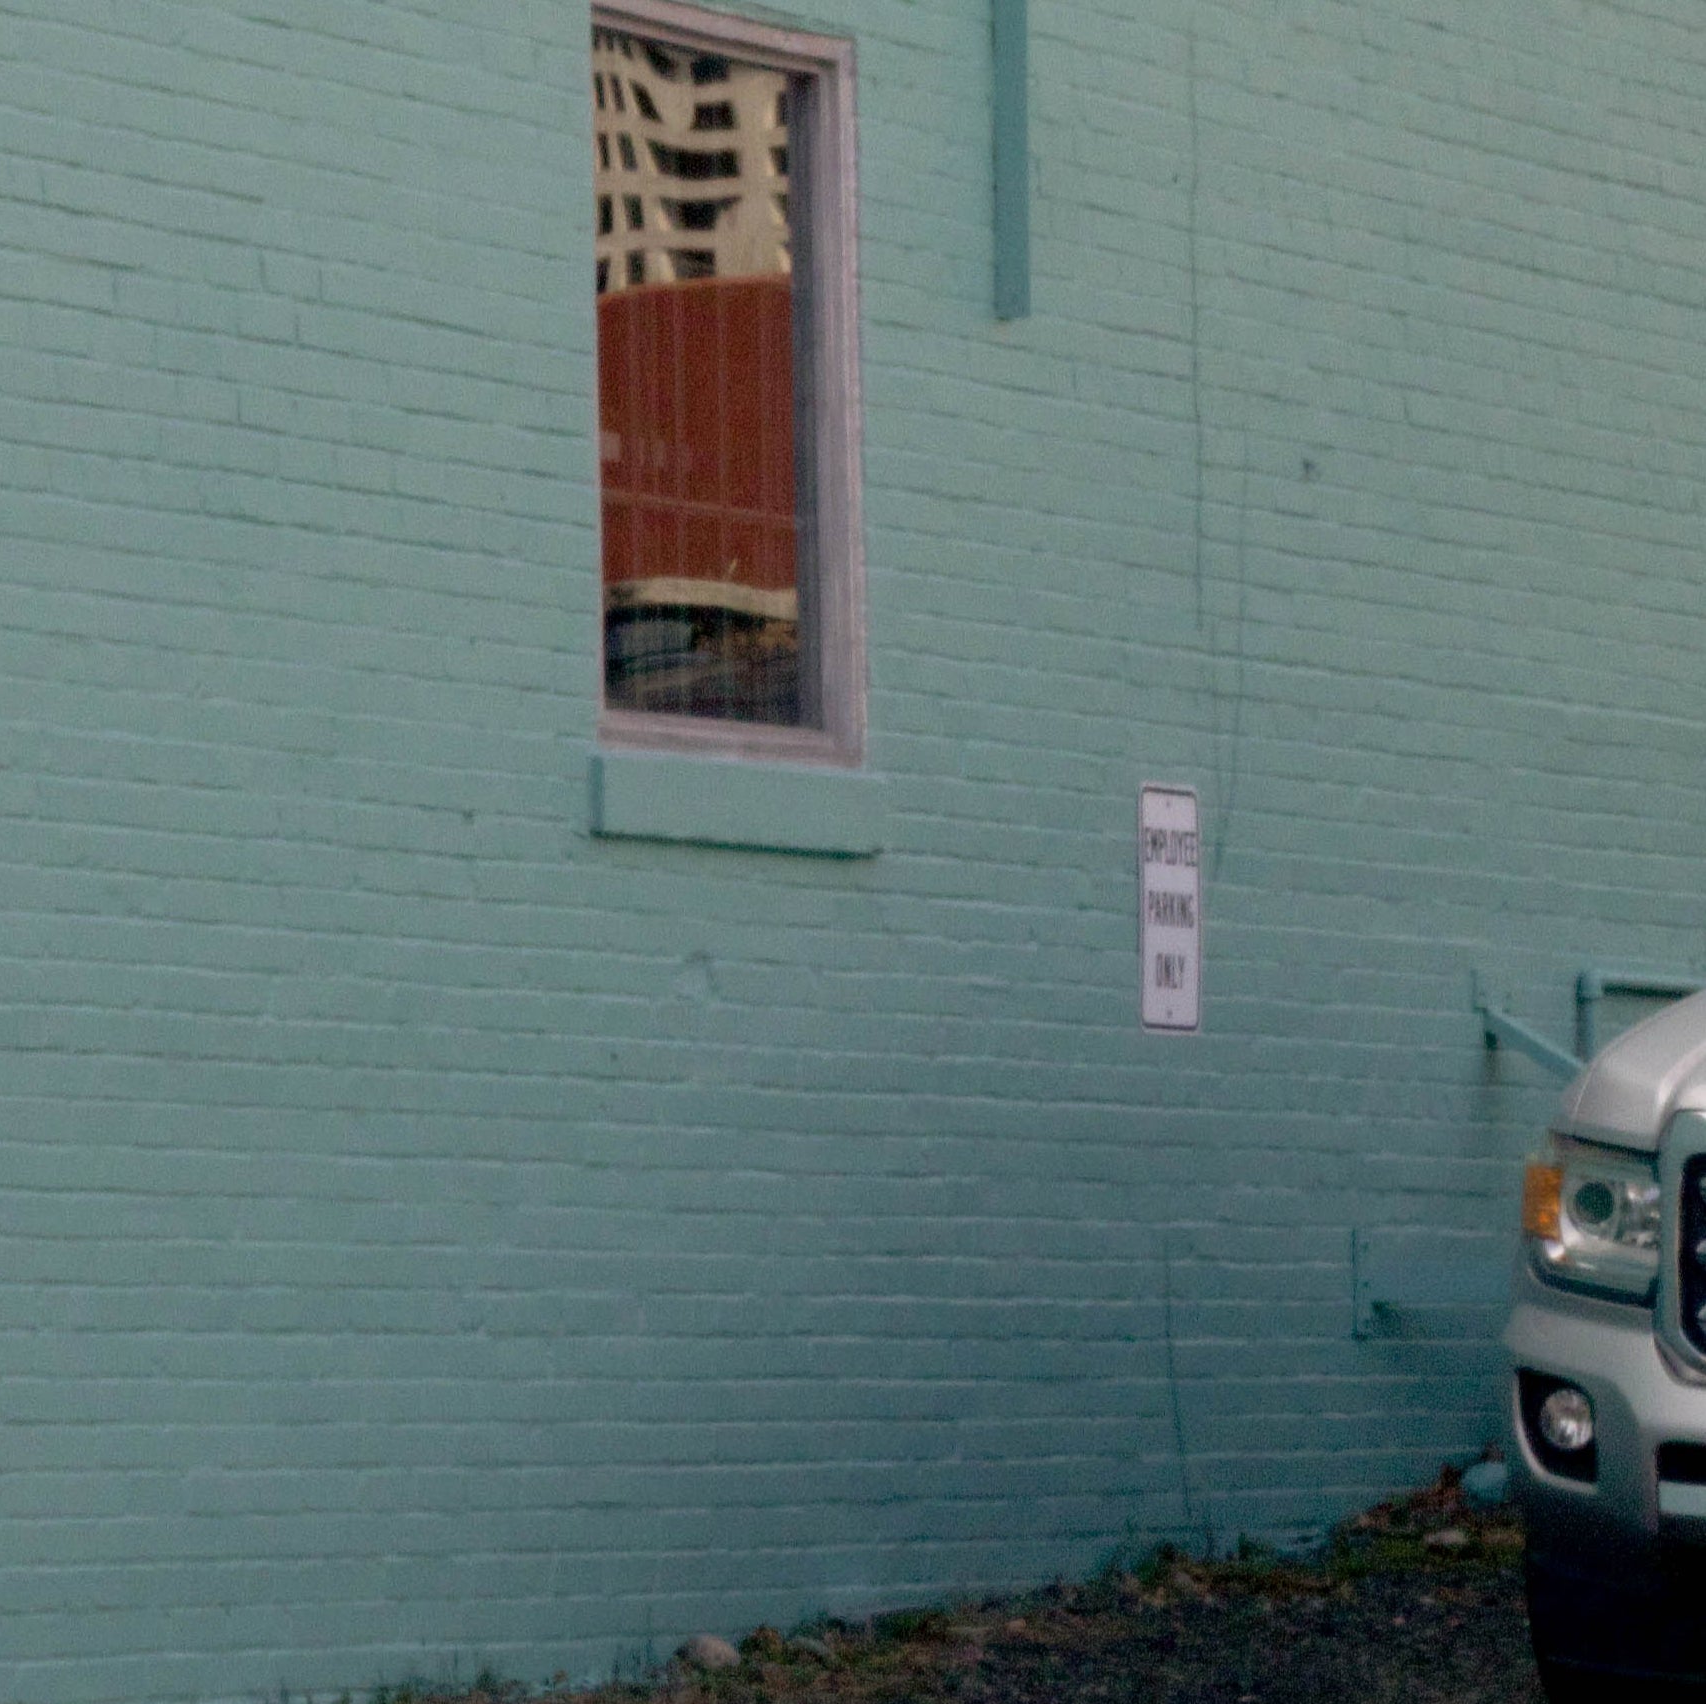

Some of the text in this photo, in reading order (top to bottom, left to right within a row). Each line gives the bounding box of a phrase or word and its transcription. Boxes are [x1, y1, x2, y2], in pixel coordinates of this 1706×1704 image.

[1143, 827, 1198, 868] EMPLOYEE
[1147, 890, 1195, 929] PARKING
[1155, 952, 1187, 989] ONLY
